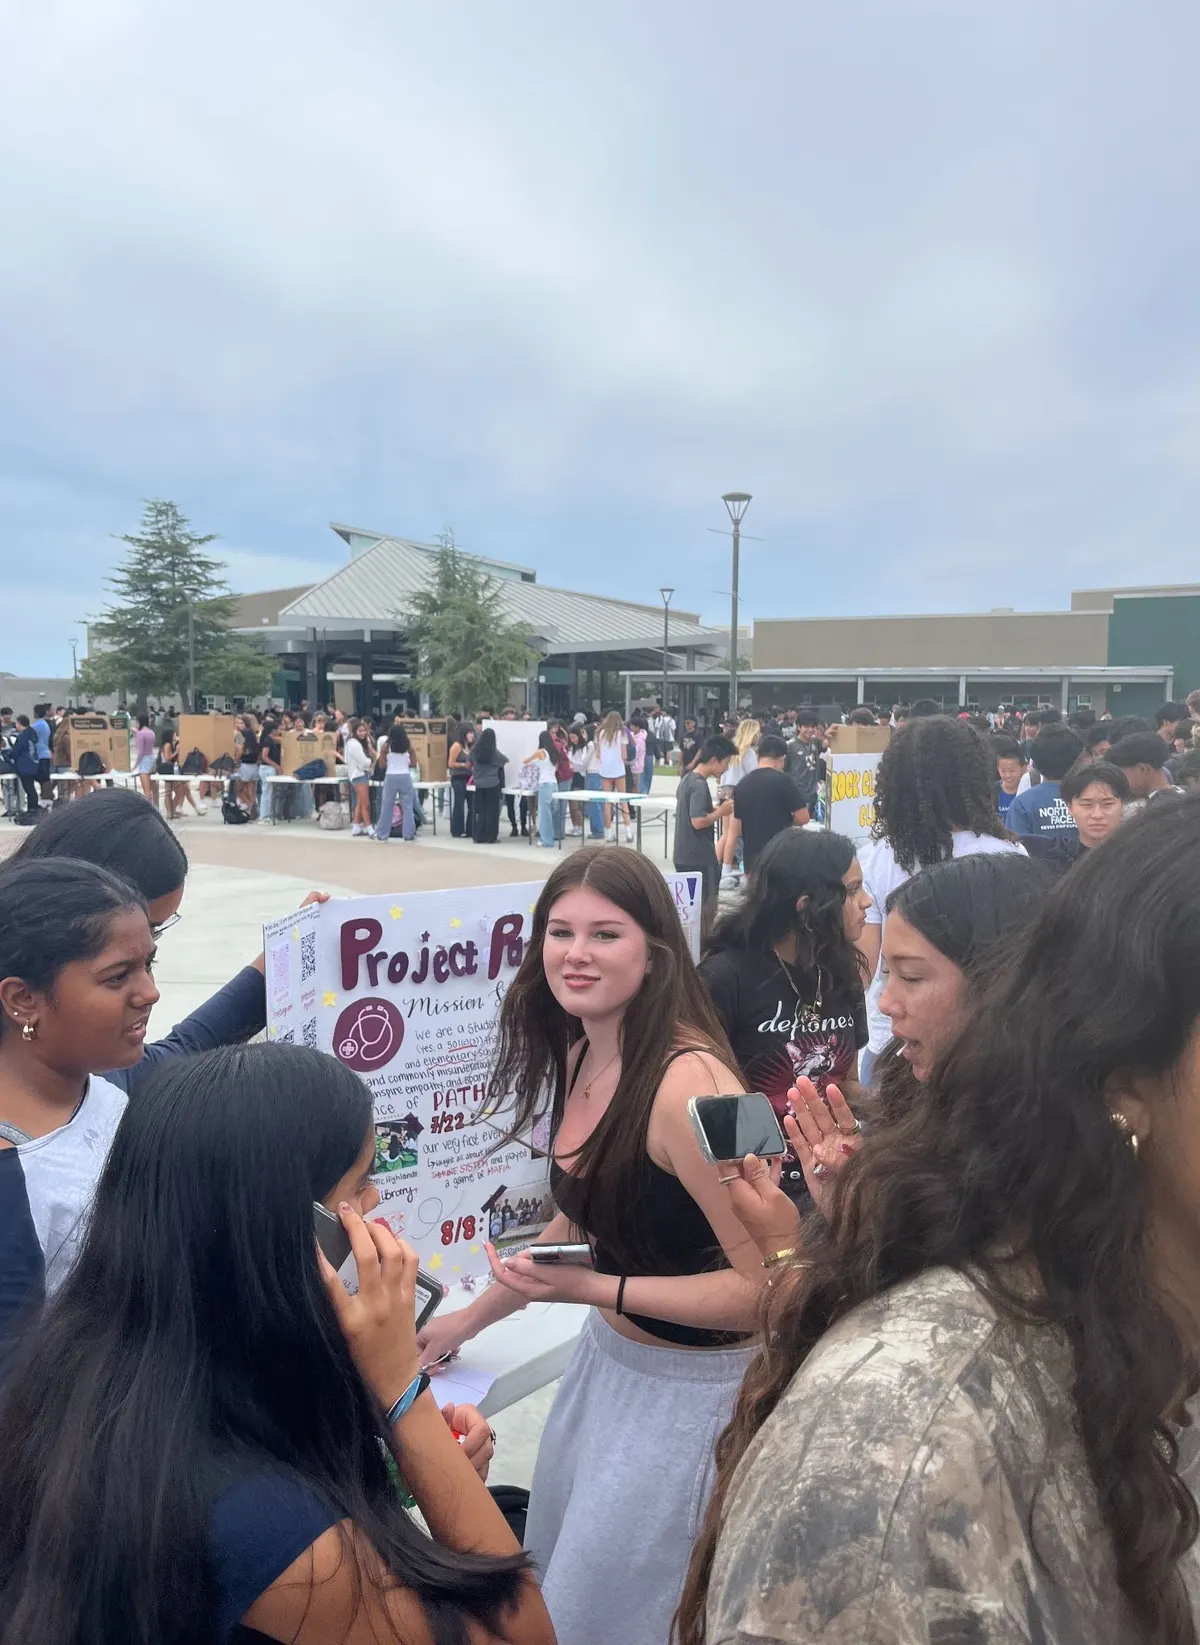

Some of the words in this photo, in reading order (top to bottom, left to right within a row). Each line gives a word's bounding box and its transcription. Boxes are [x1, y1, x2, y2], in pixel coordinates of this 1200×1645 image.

[831, 770, 860, 803] ROCK
[862, 769, 877, 797] CL
[1053, 798, 1067, 807] Th
[340, 917, 479, 991] Project
[487, 913, 529, 980] Pa
[402, 995, 485, 1019] Mission
[436, 1026, 454, 1039] are
[457, 1024, 465, 1034] a
[437, 1042, 444, 1051] a
[404, 1059, 421, 1070] and
[423, 1049, 477, 1067] elementary
[366, 1074, 386, 1088] and
[387, 1067, 436, 1084] commonly
[446, 1077, 462, 1088] and
[406, 1095, 420, 1110] of
[442, 1138, 461, 1154] very
[462, 1132, 480, 1148] first
[490, 1154, 503, 1164] and
[505, 1148, 528, 1164] played
[444, 1179, 451, 1189] a
[453, 1174, 475, 1189] game
[477, 1169, 485, 1180] of
[487, 1163, 511, 1176] MAFIA
